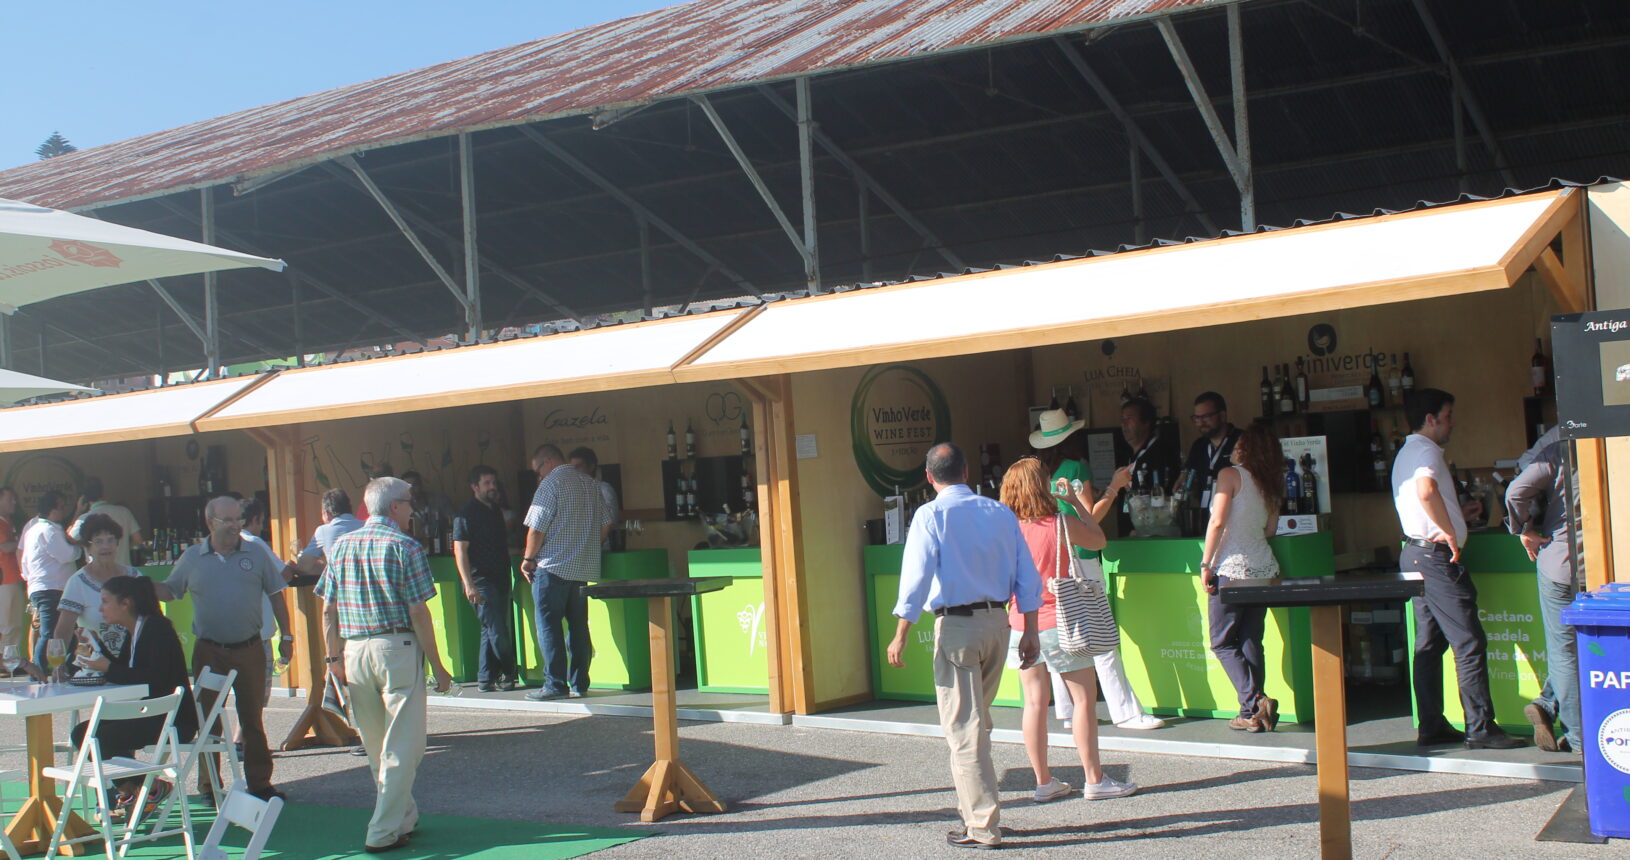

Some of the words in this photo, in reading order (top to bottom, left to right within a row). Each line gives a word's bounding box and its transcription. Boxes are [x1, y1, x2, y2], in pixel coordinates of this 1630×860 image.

[1584, 320, 1628, 333] Antiga
[1084, 369, 1105, 382] LUA
[543, 406, 609, 430] Gazela
[874, 428, 904, 440] WINE
[906, 427, 932, 438] FEST
[1477, 609, 1533, 622] Caetano
[1487, 628, 1530, 642] sadela
[1161, 649, 1195, 659] PONTE
[1487, 649, 1508, 661] nta
